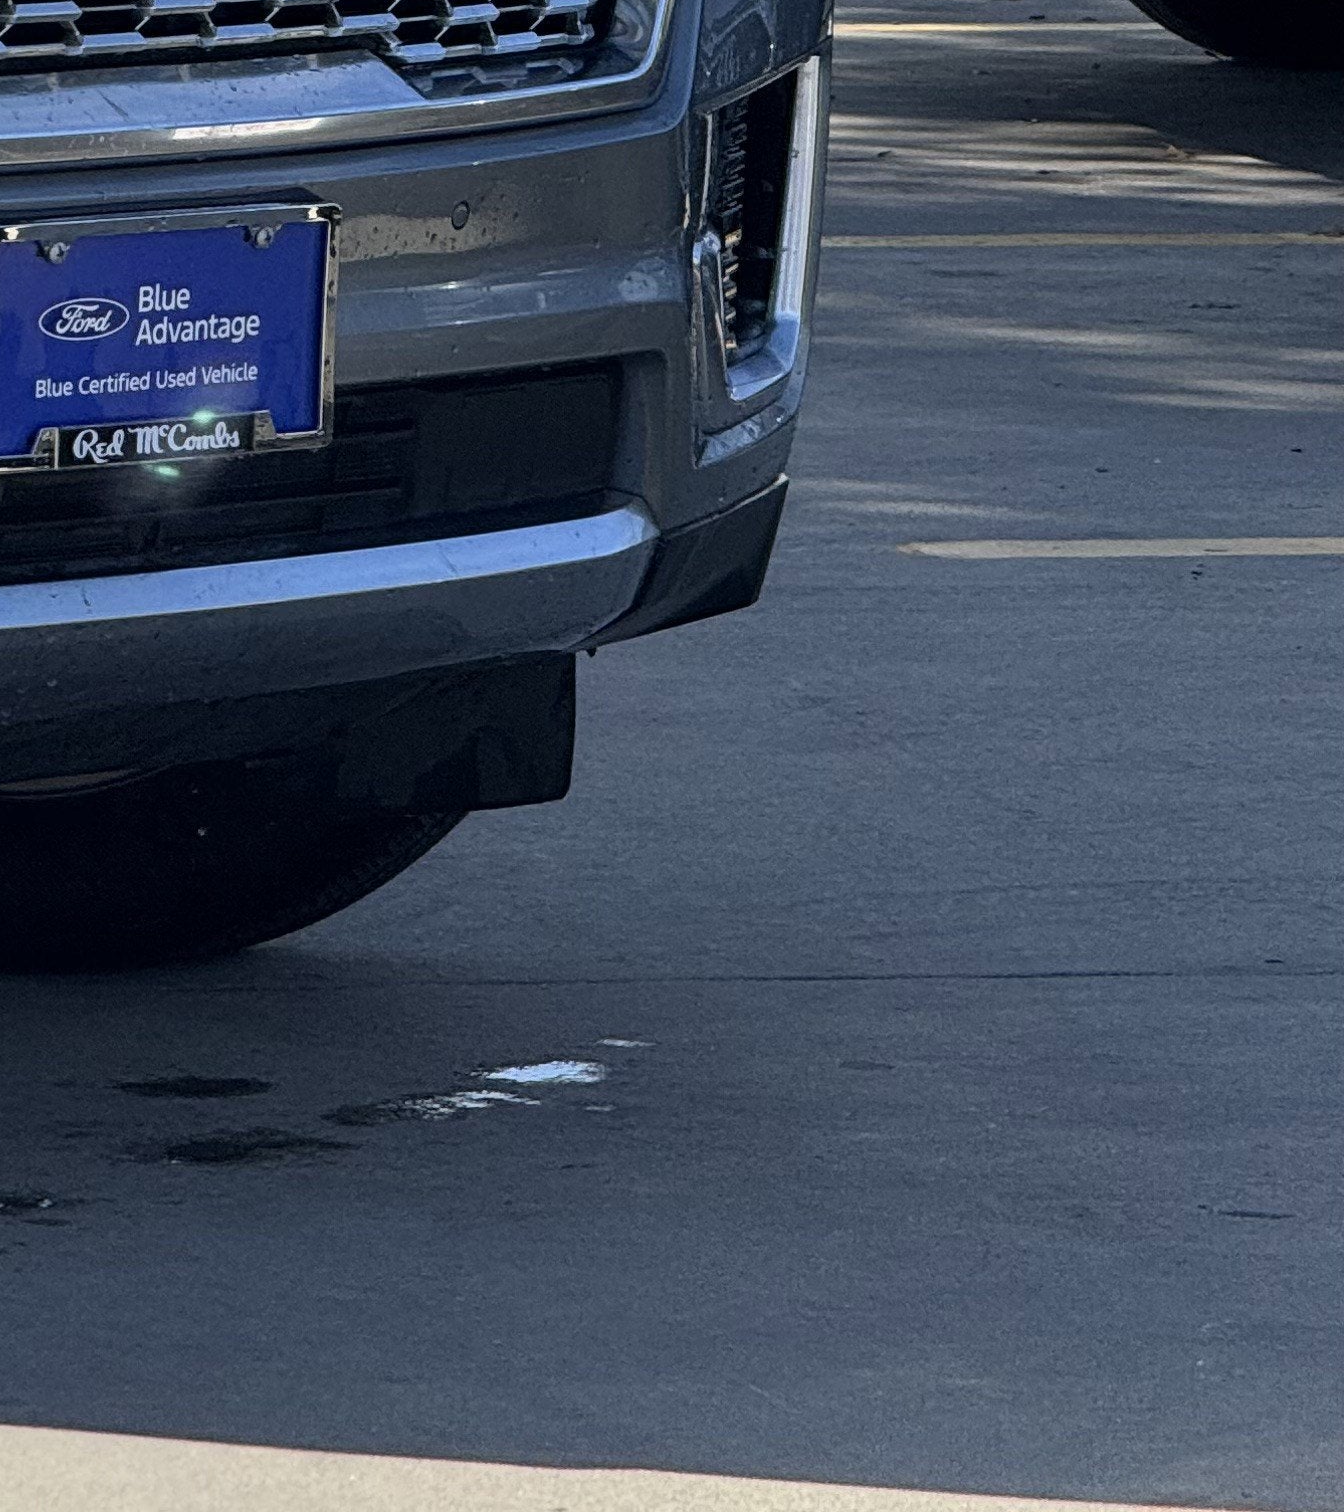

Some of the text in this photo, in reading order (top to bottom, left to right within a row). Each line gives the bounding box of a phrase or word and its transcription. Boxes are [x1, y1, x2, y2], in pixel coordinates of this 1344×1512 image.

[138, 283, 191, 313] Blue
[55, 304, 113, 334] Ford
[135, 314, 261, 346] Advantage
[35, 362, 259, 399] Blue Certified Used Vehicle
[128, 421, 241, 455] McCombs
